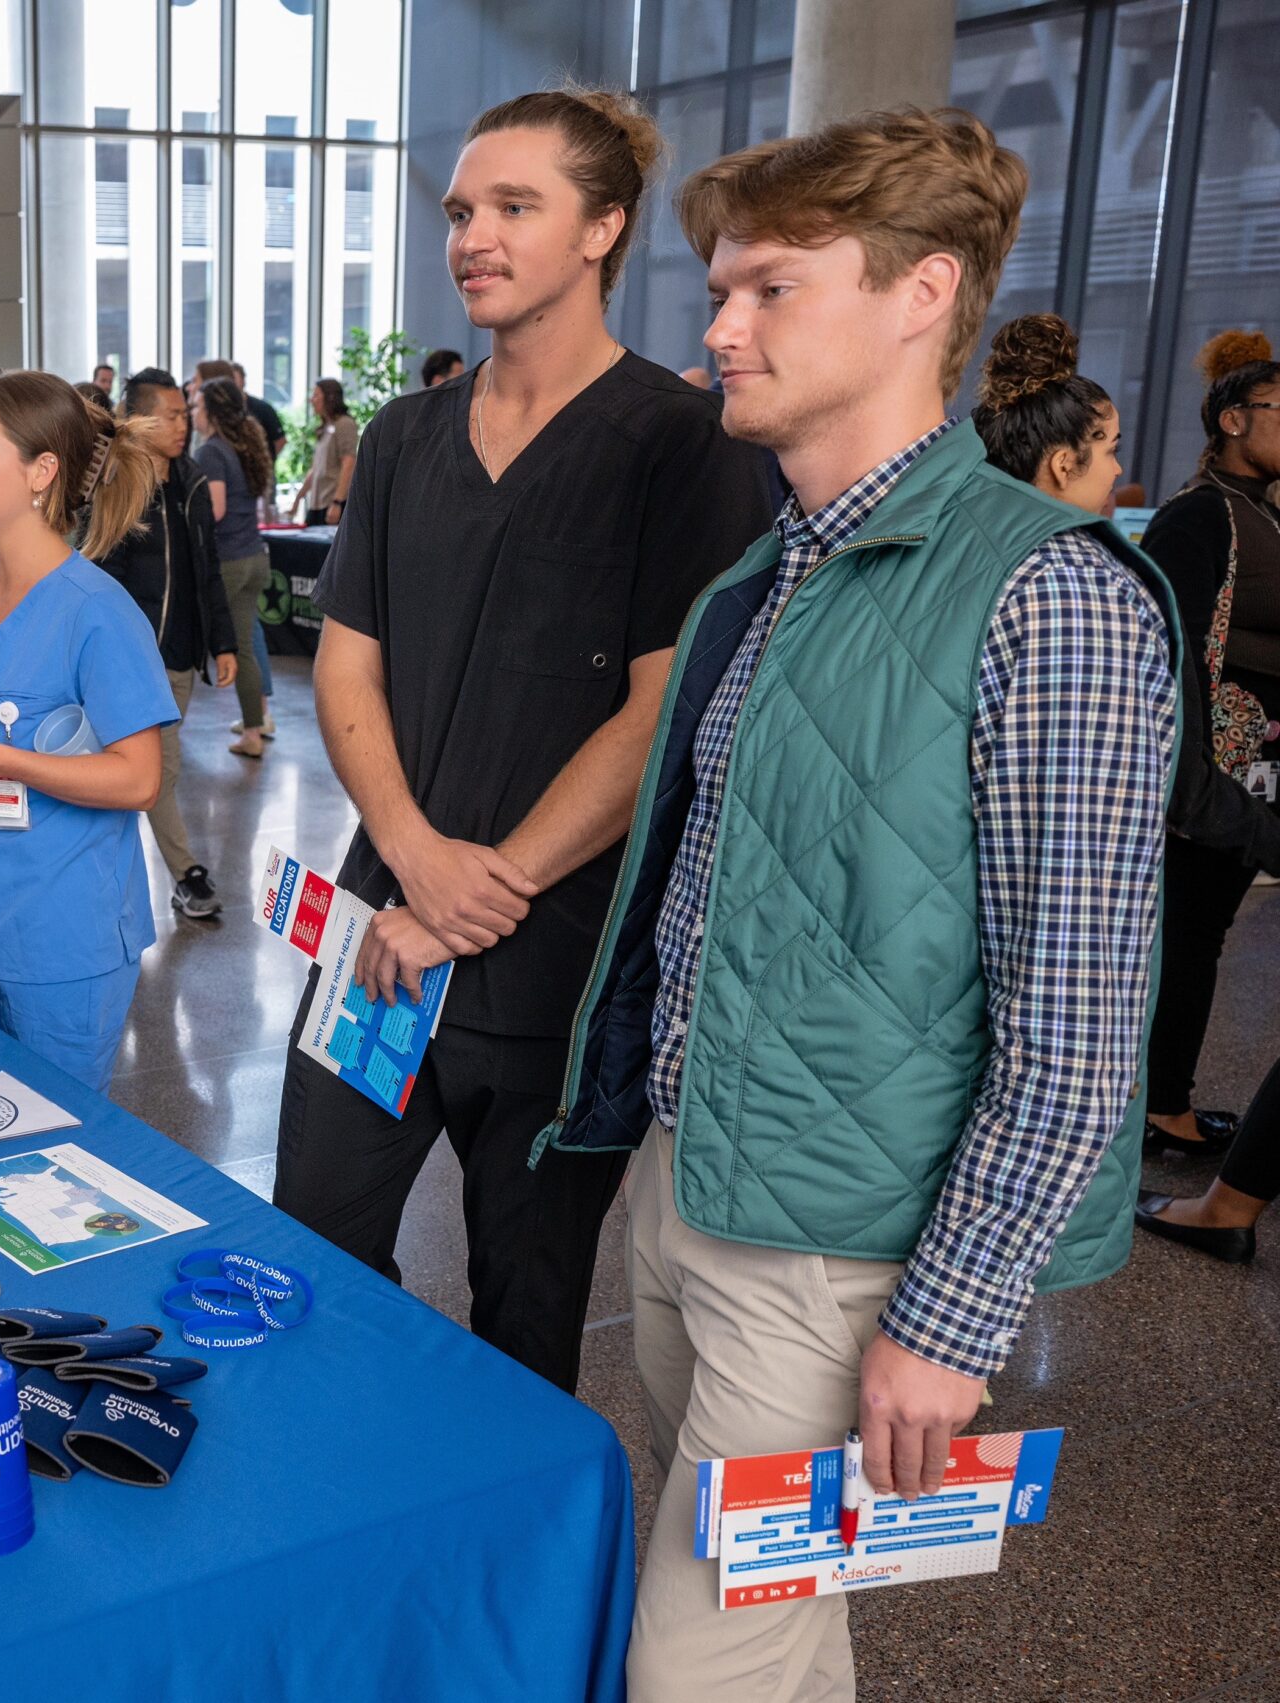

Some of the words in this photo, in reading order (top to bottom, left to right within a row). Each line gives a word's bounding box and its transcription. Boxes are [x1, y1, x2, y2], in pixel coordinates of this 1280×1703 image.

[263, 887, 277, 919] OUR
[272, 863, 296, 929] LOCATIONS
[312, 1025, 324, 1047] WHY
[318, 984, 337, 1026] KIDSCARE
[331, 956, 345, 984] HOME
[341, 917, 357, 956] HEALTH?
[17, 1389, 77, 1421] veanna
[24, 1385, 73, 1410] healthcare
[109, 1393, 160, 1418] healthcare
[105, 1398, 180, 1437] aveanna
[961, 1475, 976, 1483] THE
[727, 1500, 746, 1509] APPLY
[947, 1507, 962, 1515] Auto
[769, 1512, 799, 1523] Company
[738, 1529, 775, 1541] Mentorships
[890, 1528, 905, 1536] Path
[911, 1522, 951, 1535] Development
[778, 1542, 794, 1550] Time
[787, 1554, 807, 1563] Teams
[832, 1564, 902, 1582] KidsCare
